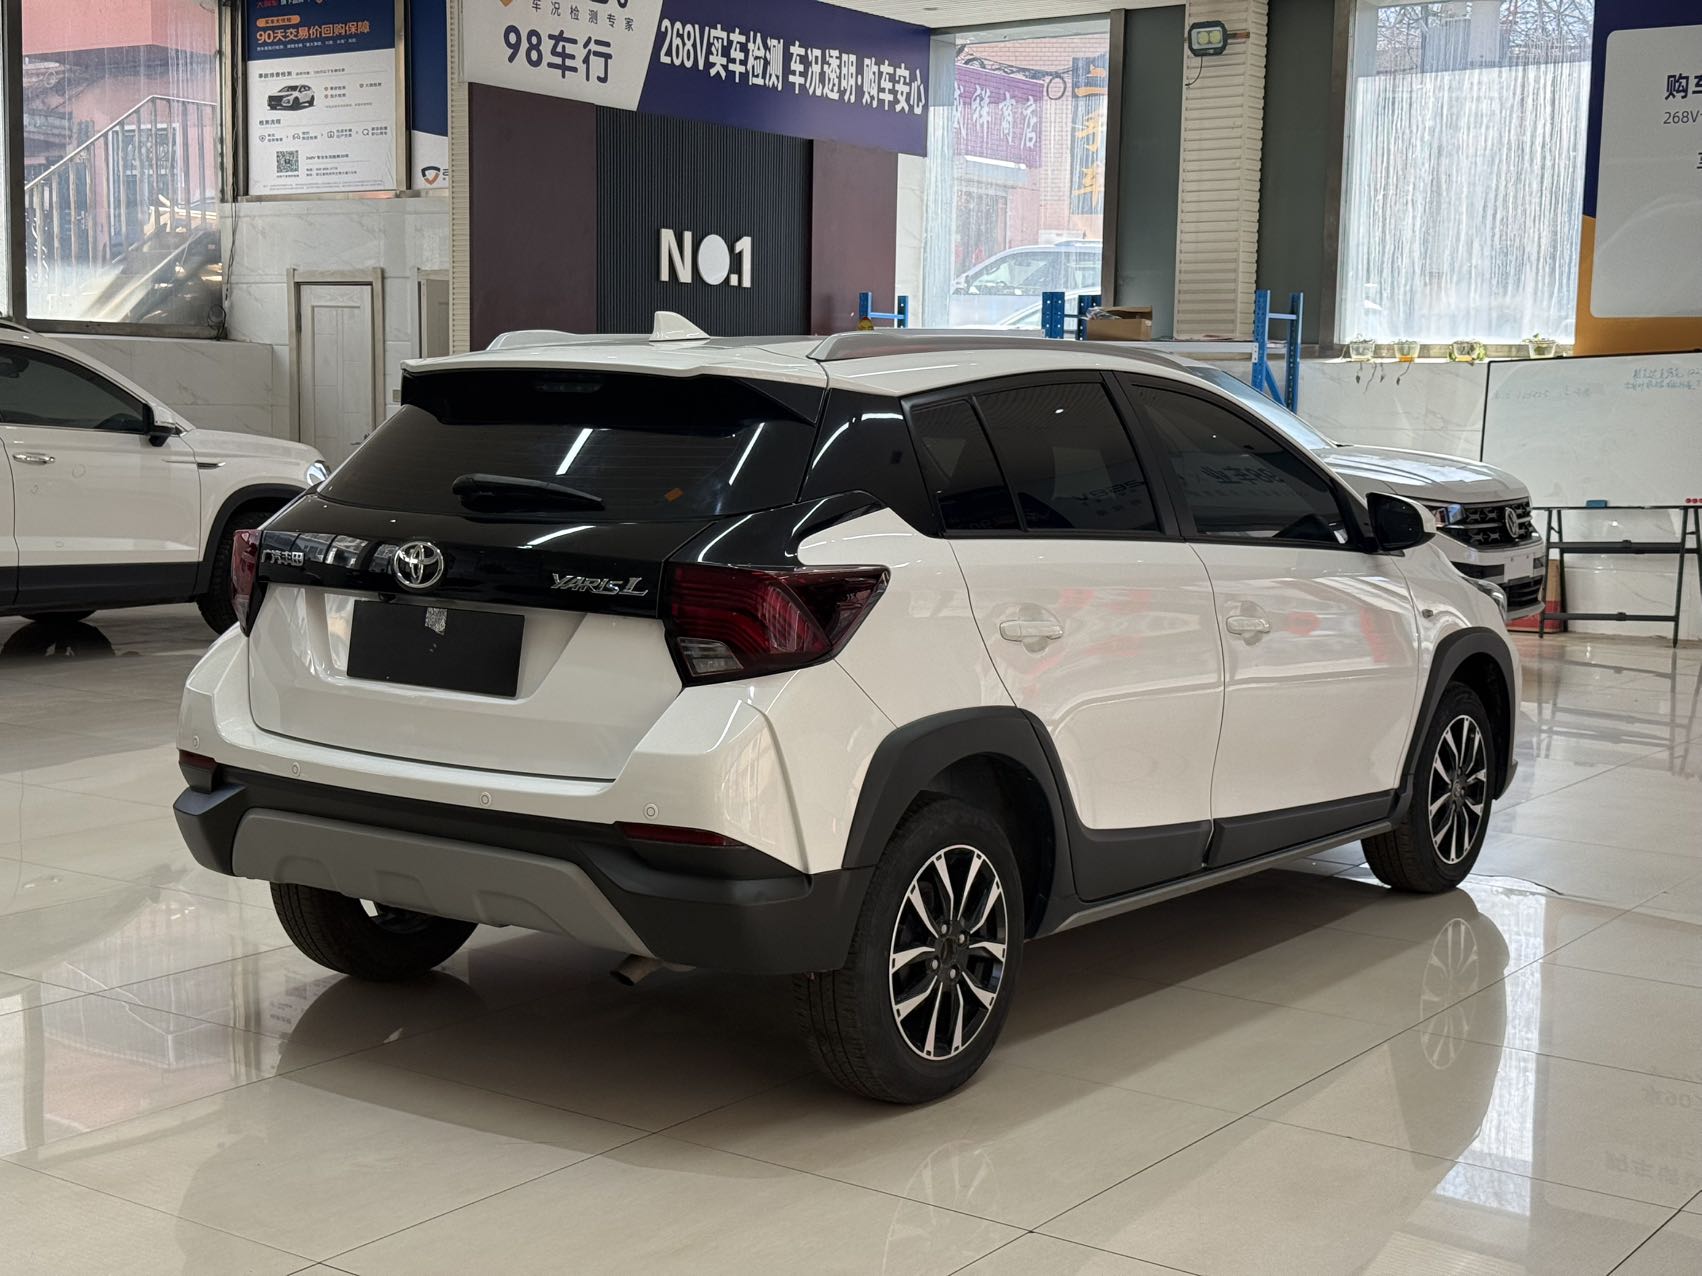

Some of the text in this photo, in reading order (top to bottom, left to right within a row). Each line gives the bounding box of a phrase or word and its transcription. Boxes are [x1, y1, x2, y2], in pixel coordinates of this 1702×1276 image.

[256, 21, 370, 43] 90天交易价回购保障
[532, 0, 635, 32] 车况检测专家
[503, 24, 613, 84] 98车行
[659, 18, 926, 115] 268V实车检测 车况透明·购车安心
[1663, 110, 1702, 125] 268V
[660, 228, 752, 288] NO.1
[551, 572, 620, 595] YARIS
